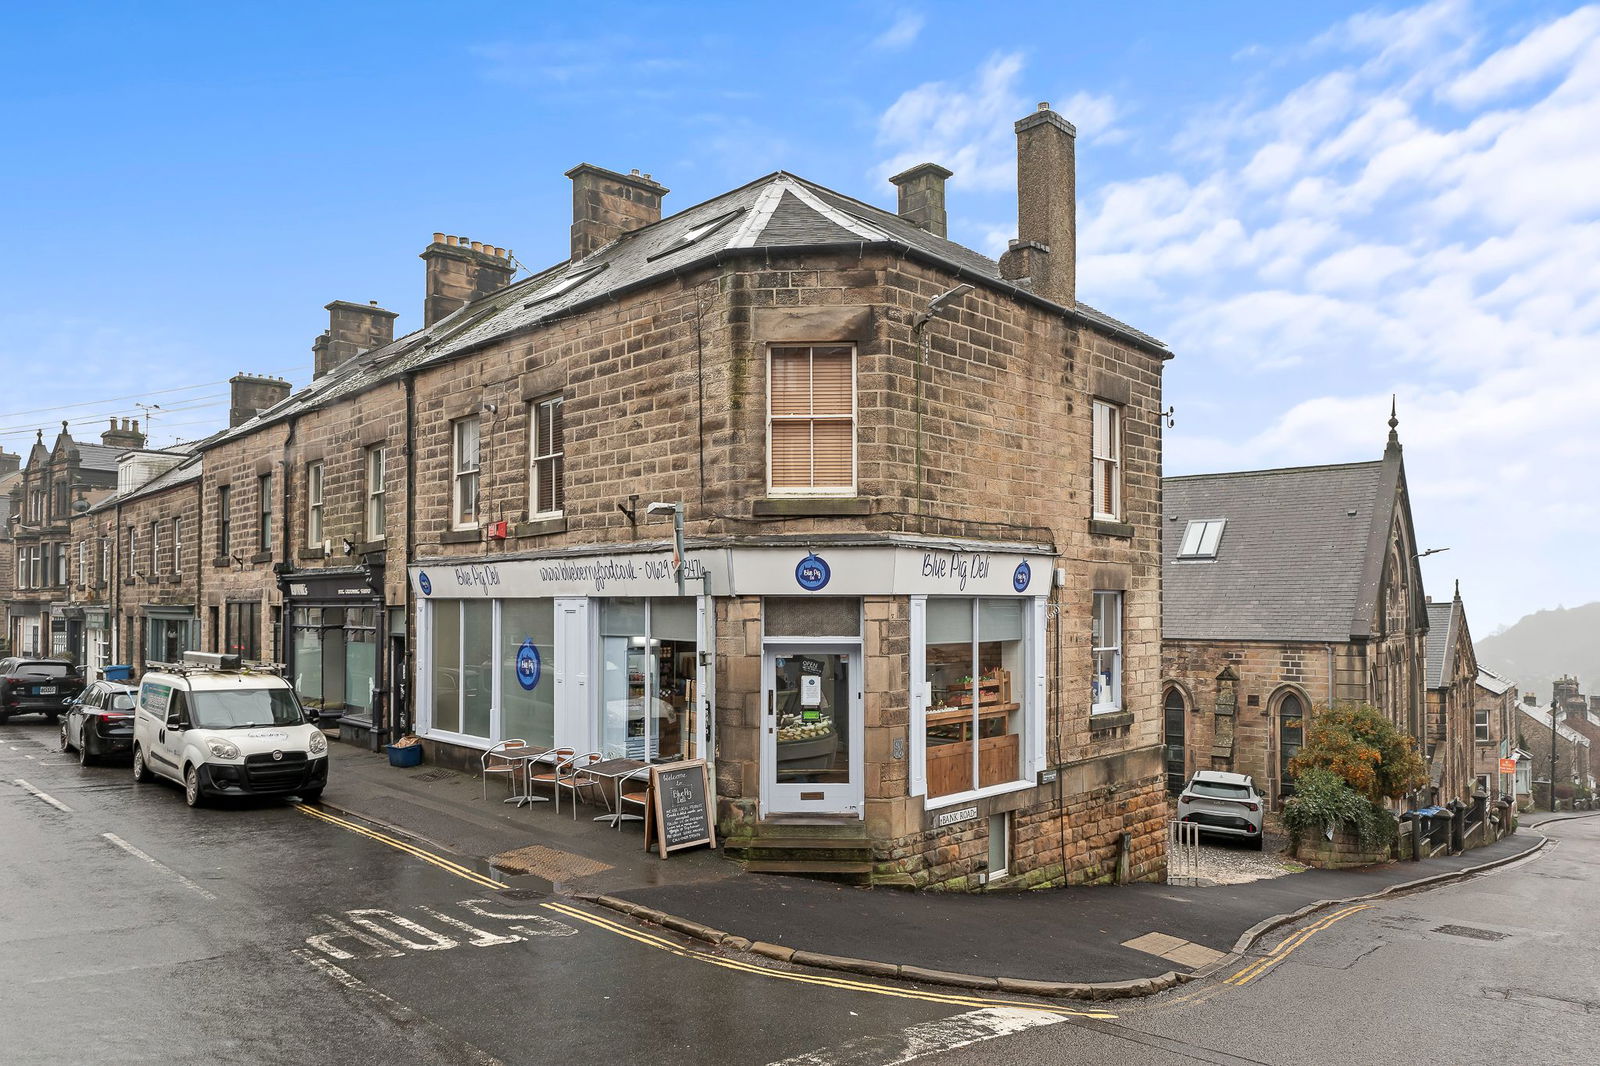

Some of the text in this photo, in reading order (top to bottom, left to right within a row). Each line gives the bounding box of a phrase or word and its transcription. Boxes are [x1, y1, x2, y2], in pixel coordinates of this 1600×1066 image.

[644, 559, 671, 581] 01629
[921, 552, 991, 592] Blue Pig Deli
[455, 564, 500, 596] Blue Pig Deli
[802, 660, 819, 669] OPEN
[663, 773, 687, 781] Welcome
[942, 809, 975, 825] BANK ROAD
